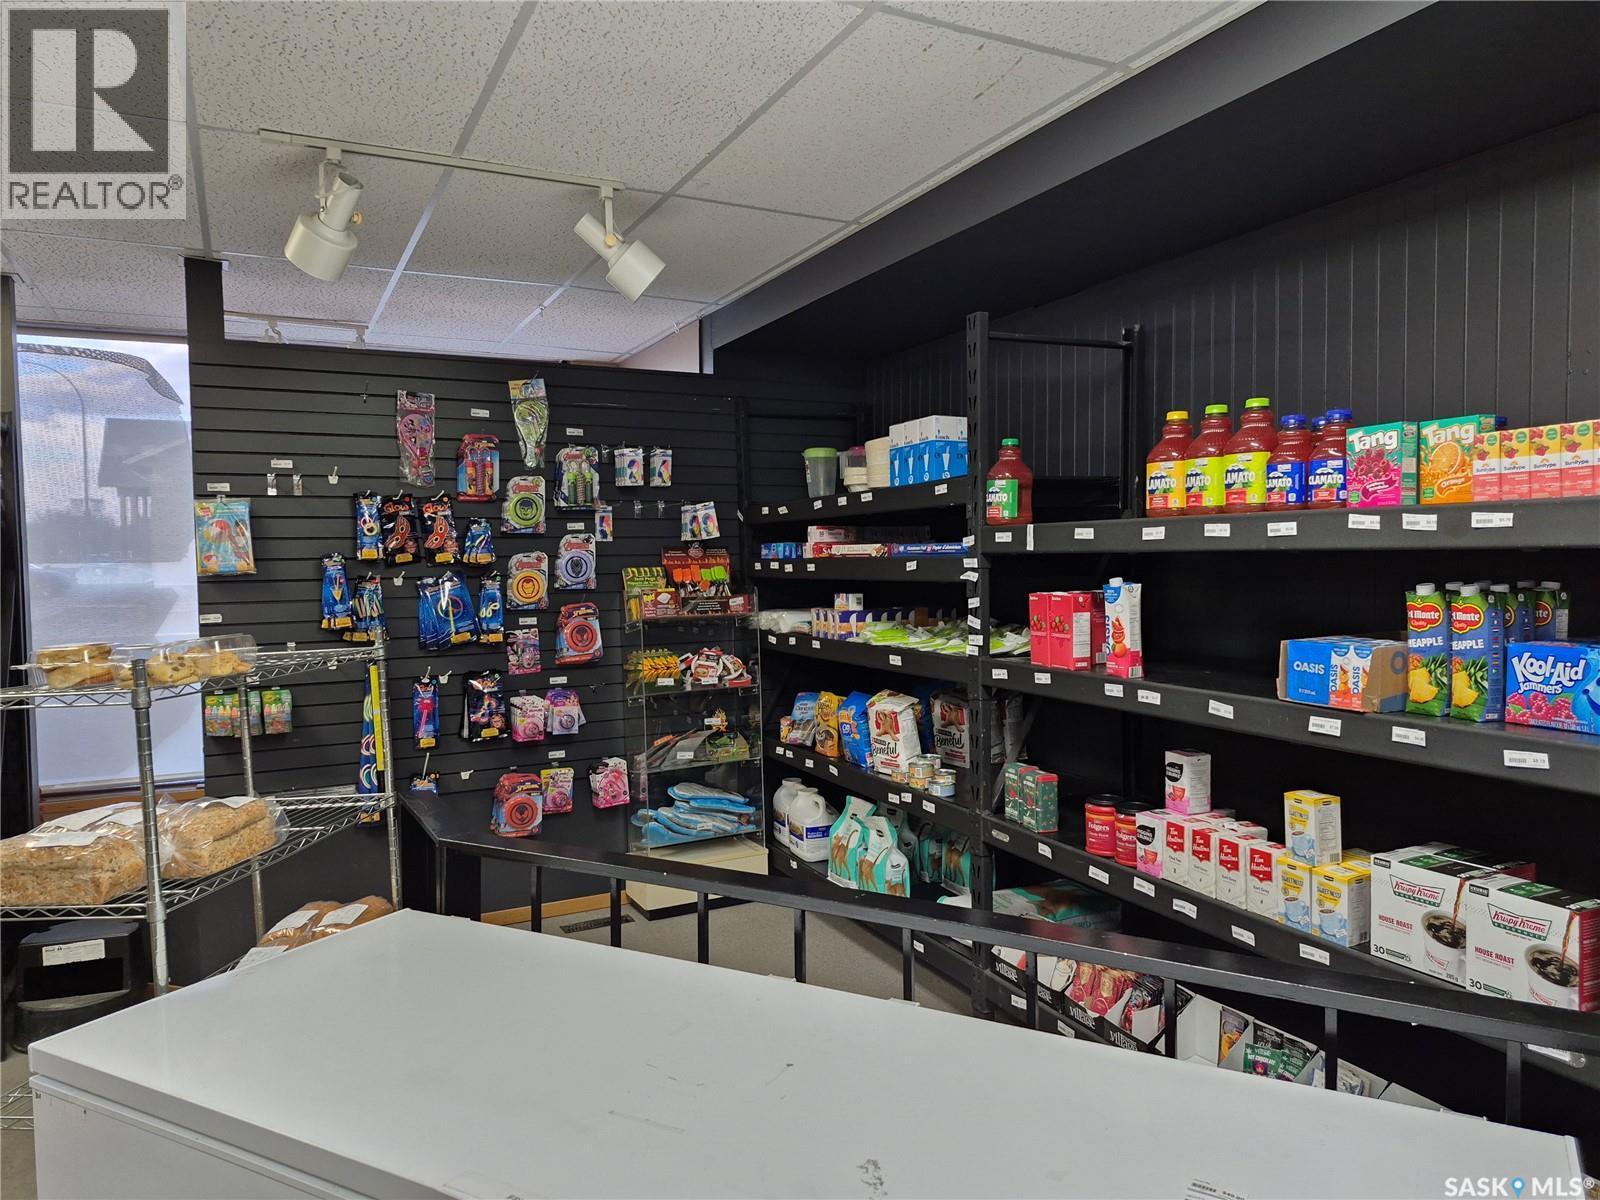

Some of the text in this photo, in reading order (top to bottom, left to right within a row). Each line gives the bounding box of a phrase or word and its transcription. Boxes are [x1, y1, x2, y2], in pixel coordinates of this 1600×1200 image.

[1348, 430, 1399, 451] Tang
[1423, 424, 1475, 447] Tang
[1147, 478, 1177, 490] LAMATO
[1185, 475, 1211, 488] AMATO
[1224, 472, 1256, 484] AMATO
[1266, 478, 1293, 488] LAMATO
[1308, 474, 1344, 484] CLAMATO
[986, 493, 1008, 502] LAMATO
[1414, 610, 1440, 619] Monte
[1456, 612, 1480, 621] Monte
[1293, 660, 1326, 674] OASIS
[1512, 652, 1586, 686] Kool-Aid
[1330, 664, 1338, 692] OASIS
[1352, 666, 1360, 694] OASIS
[935, 732, 962, 748] Beneful
[1088, 822, 1110, 831] Folgers
[1169, 828, 1179, 836] Tim
[1194, 835, 1204, 844] Tim
[1222, 845, 1232, 854] Tim
[1253, 854, 1264, 863] Tim
[1394, 880, 1417, 896] Krispy
[1416, 887, 1440, 901] Kreme
[1378, 914, 1413, 930] HOUSE ROAST
[1492, 910, 1518, 926] Krispy
[1518, 918, 1546, 934] Kreme
[1373, 944, 1385, 954] 30
[1474, 946, 1515, 965] HOUSE ROAST
[1468, 978, 1482, 990] 30
